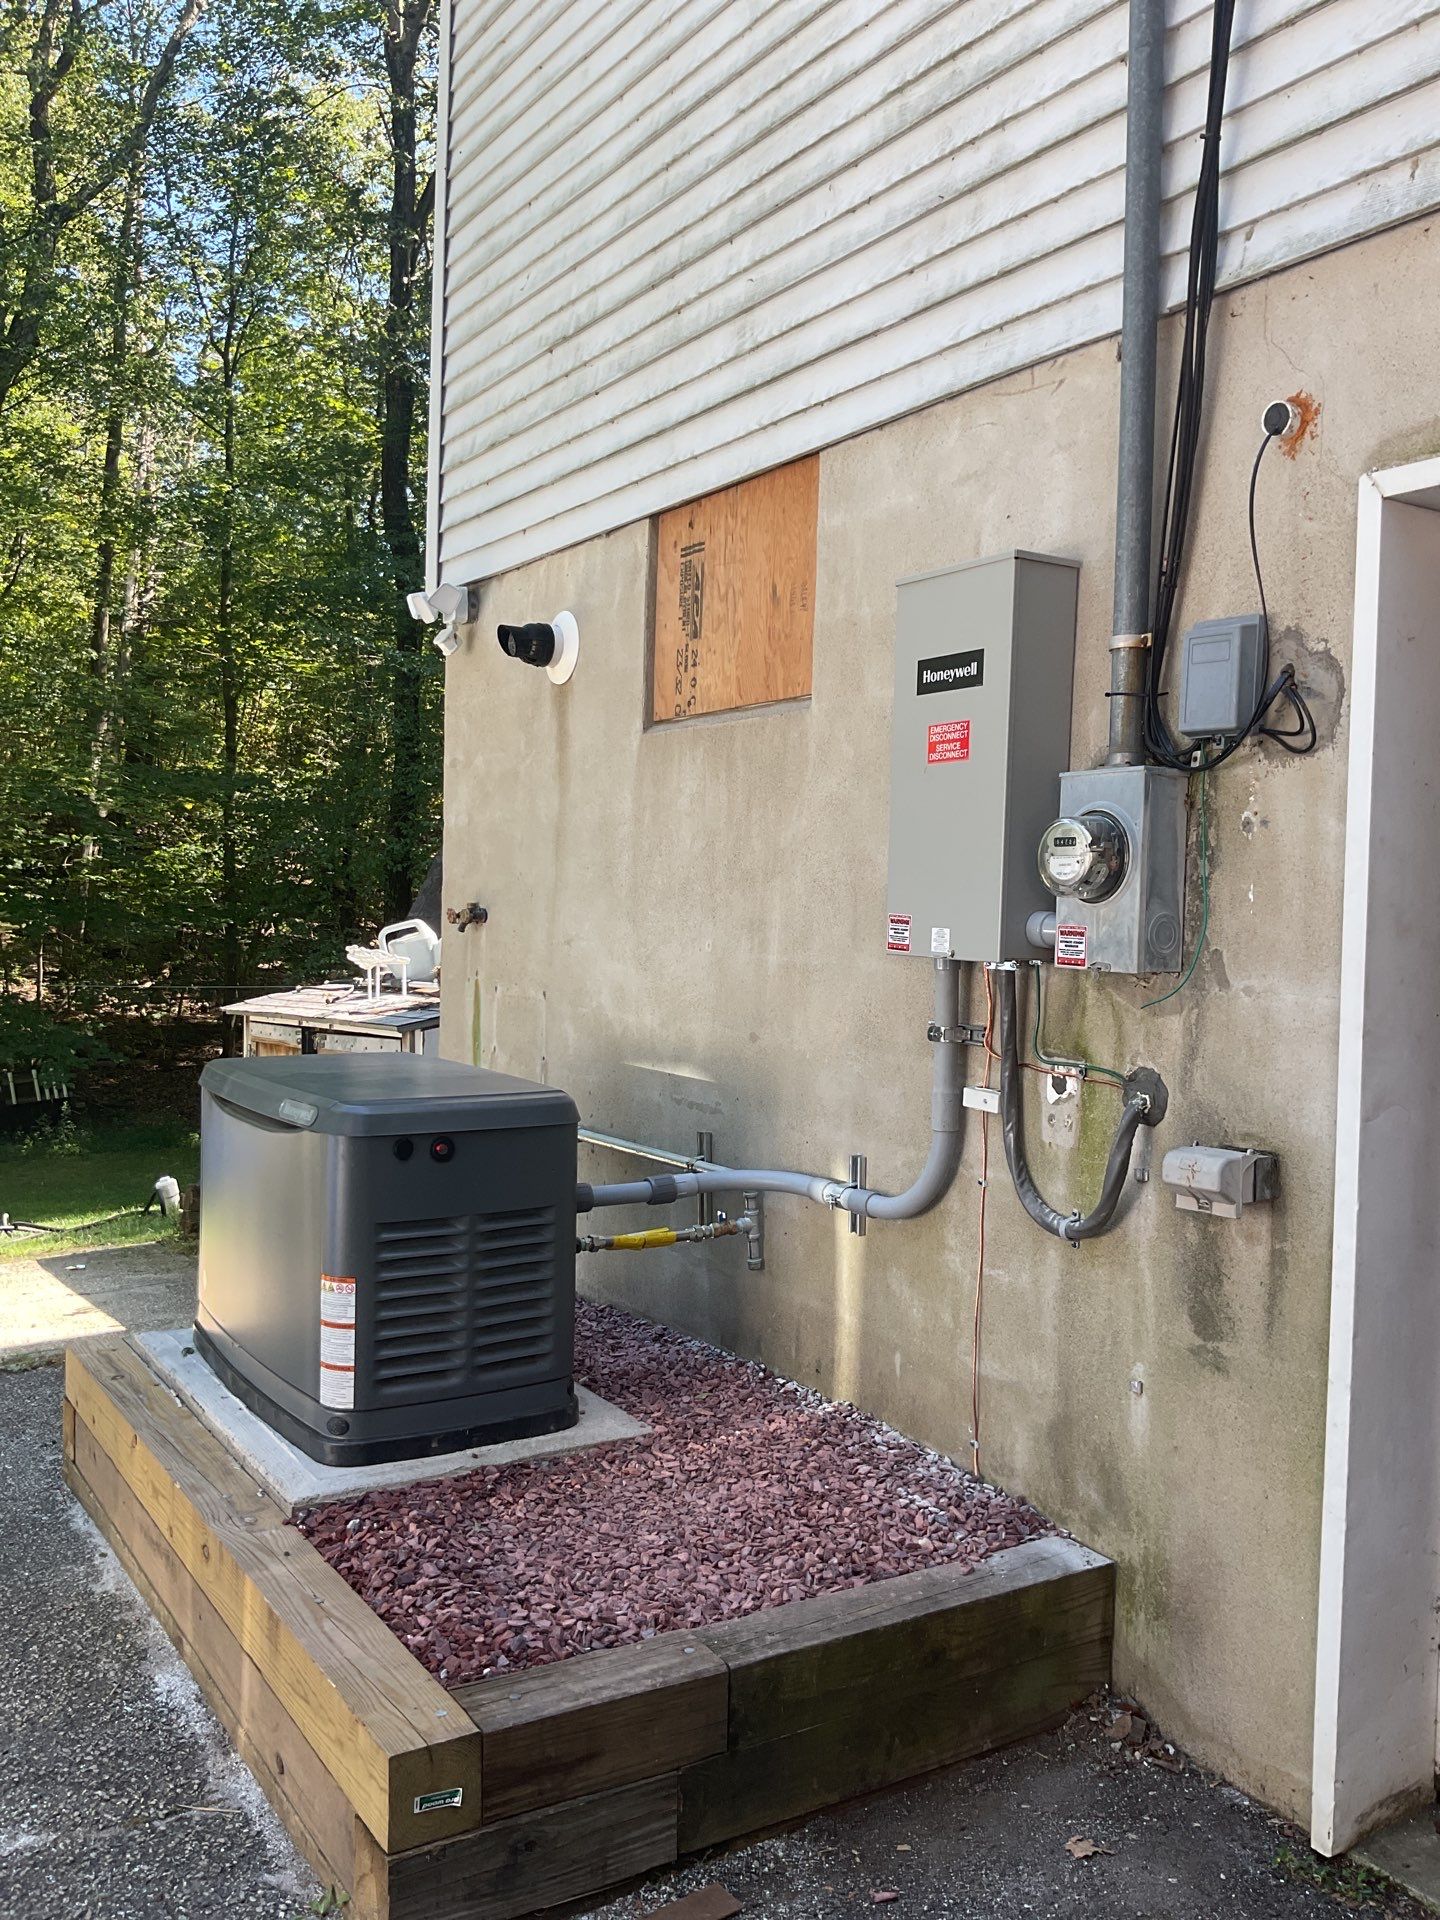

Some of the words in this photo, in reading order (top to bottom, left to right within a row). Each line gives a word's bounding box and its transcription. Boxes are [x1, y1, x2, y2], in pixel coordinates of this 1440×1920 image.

[922, 662, 977, 683] Honeywell
[930, 722, 968, 734] EMERGENCY
[929, 730, 968, 742] DISCONNECT
[935, 742, 961, 752] SERVICE
[929, 749, 968, 761] DISCONNECT
